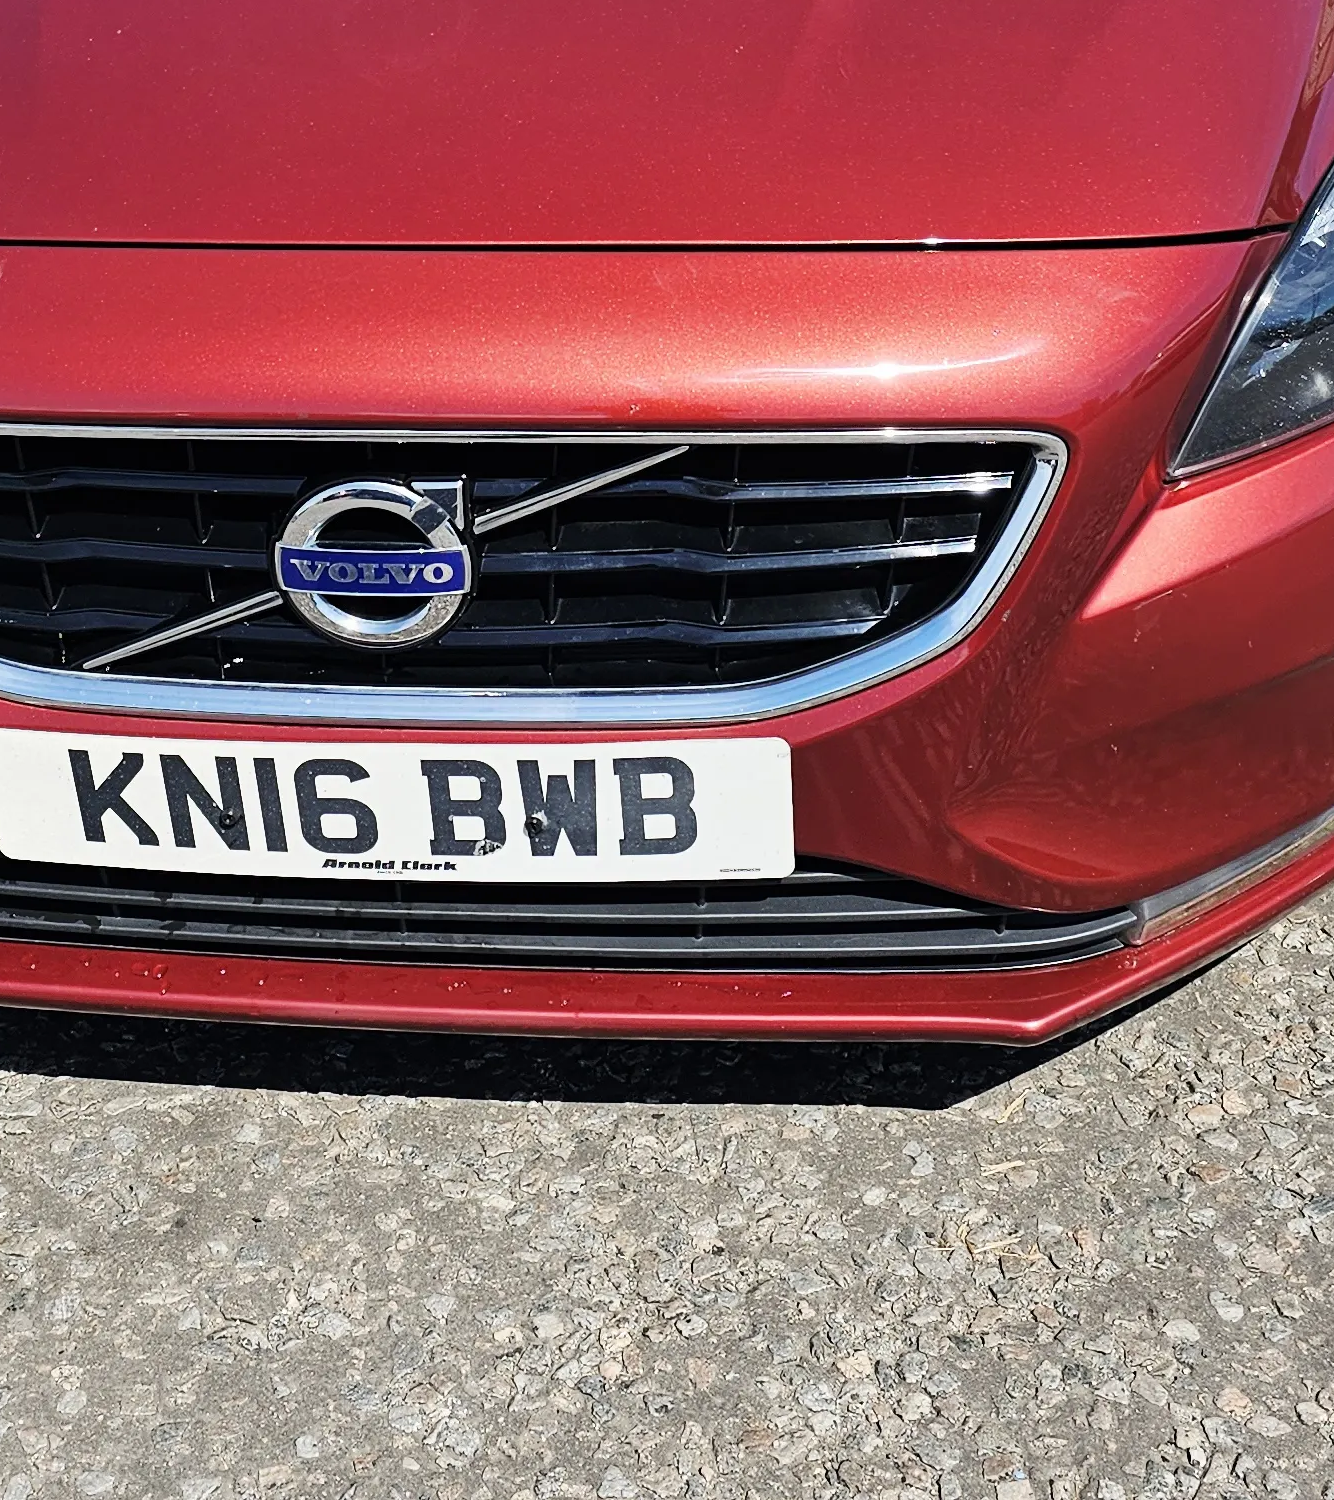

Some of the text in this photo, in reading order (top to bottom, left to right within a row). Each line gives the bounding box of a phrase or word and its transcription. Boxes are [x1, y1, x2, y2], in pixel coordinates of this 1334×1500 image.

[289, 558, 454, 585] VOLVO
[68, 748, 698, 857] KN16 BWB
[322, 858, 458, 872] Arnold Clark
